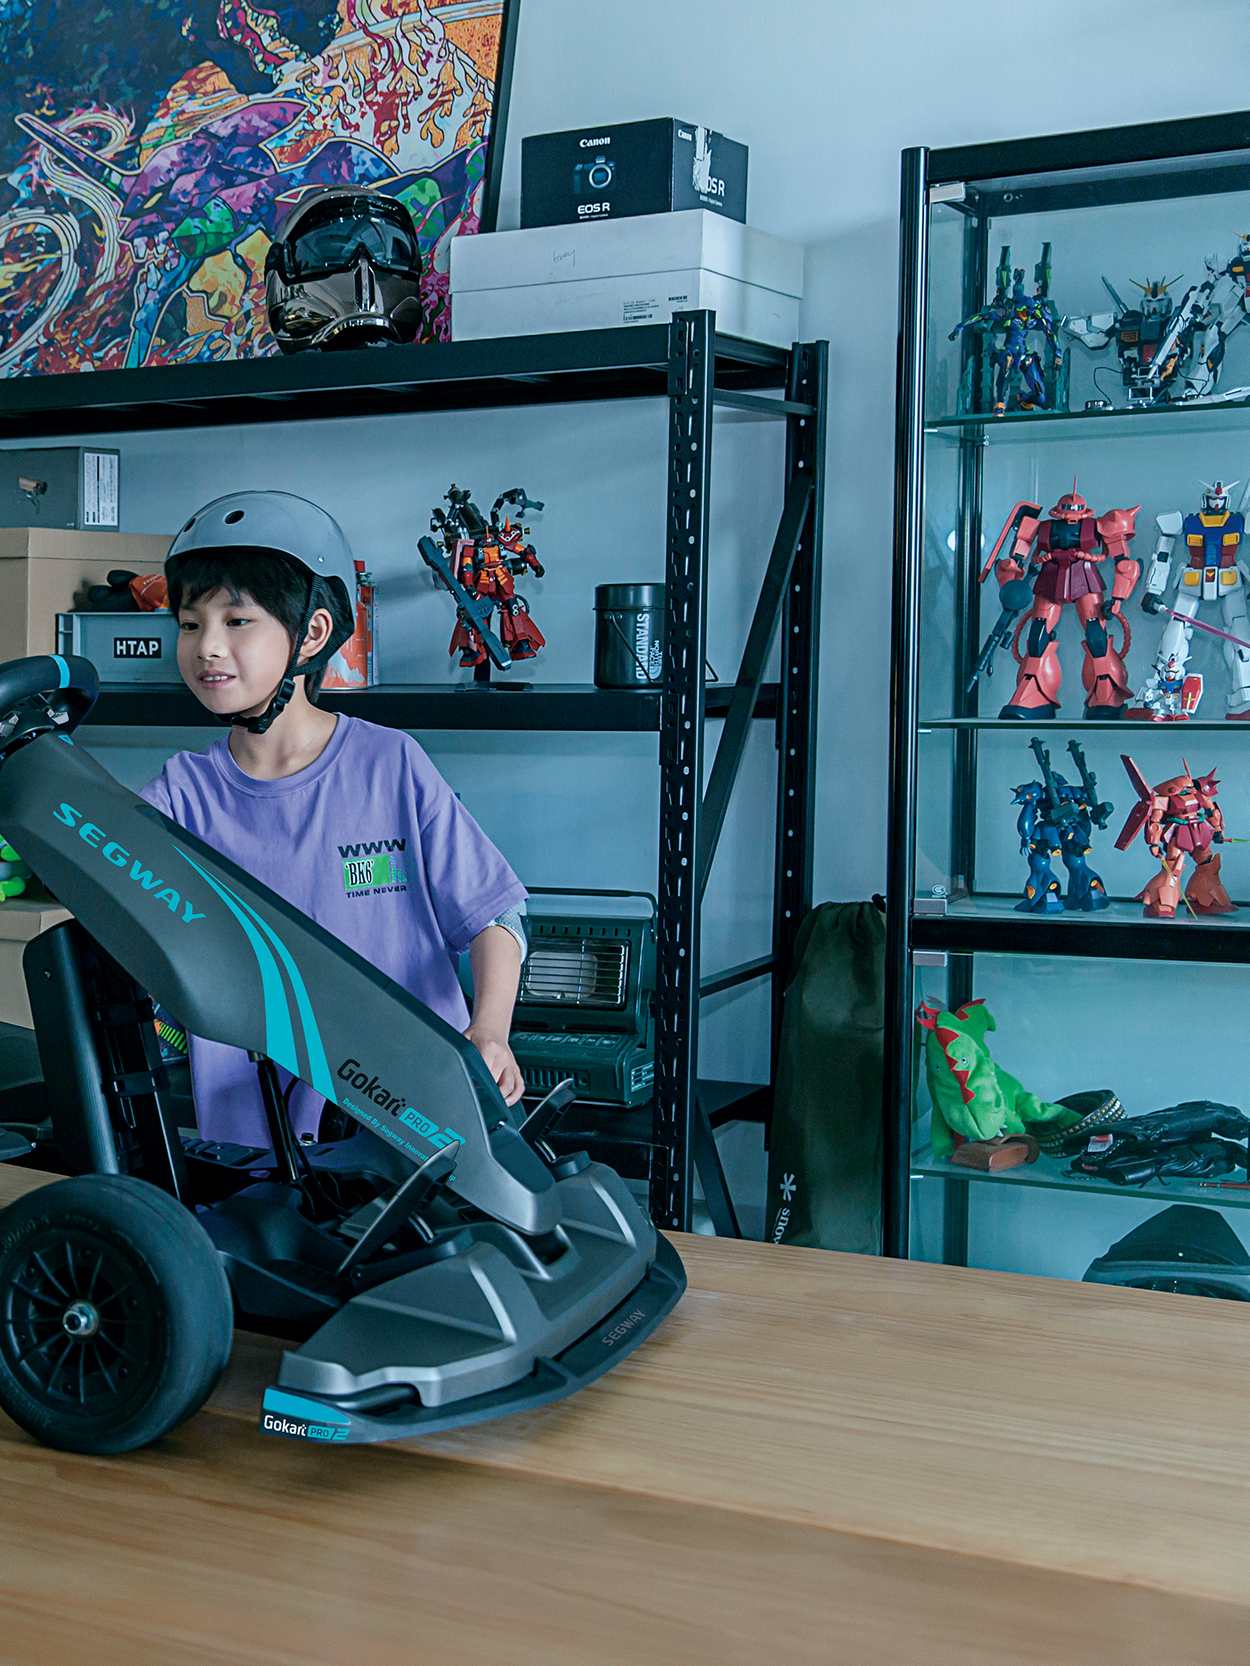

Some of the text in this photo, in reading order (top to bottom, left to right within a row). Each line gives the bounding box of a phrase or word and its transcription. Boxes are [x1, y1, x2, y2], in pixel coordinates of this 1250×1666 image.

[579, 136, 611, 148] Canon
[577, 202, 611, 214] EOS R
[116, 640, 159, 656] HTAP
[636, 613, 650, 680] STANDARD
[337, 838, 406, 858] WWW
[52, 803, 206, 923] SEGWAY
[346, 885, 407, 898] TIME NEVER
[337, 1059, 406, 1116] Gokart
[342, 1098, 431, 1161] Designed By Segway Innovat
[602, 1309, 645, 1346] SEGWAY
[264, 1415, 307, 1436] Gokart
